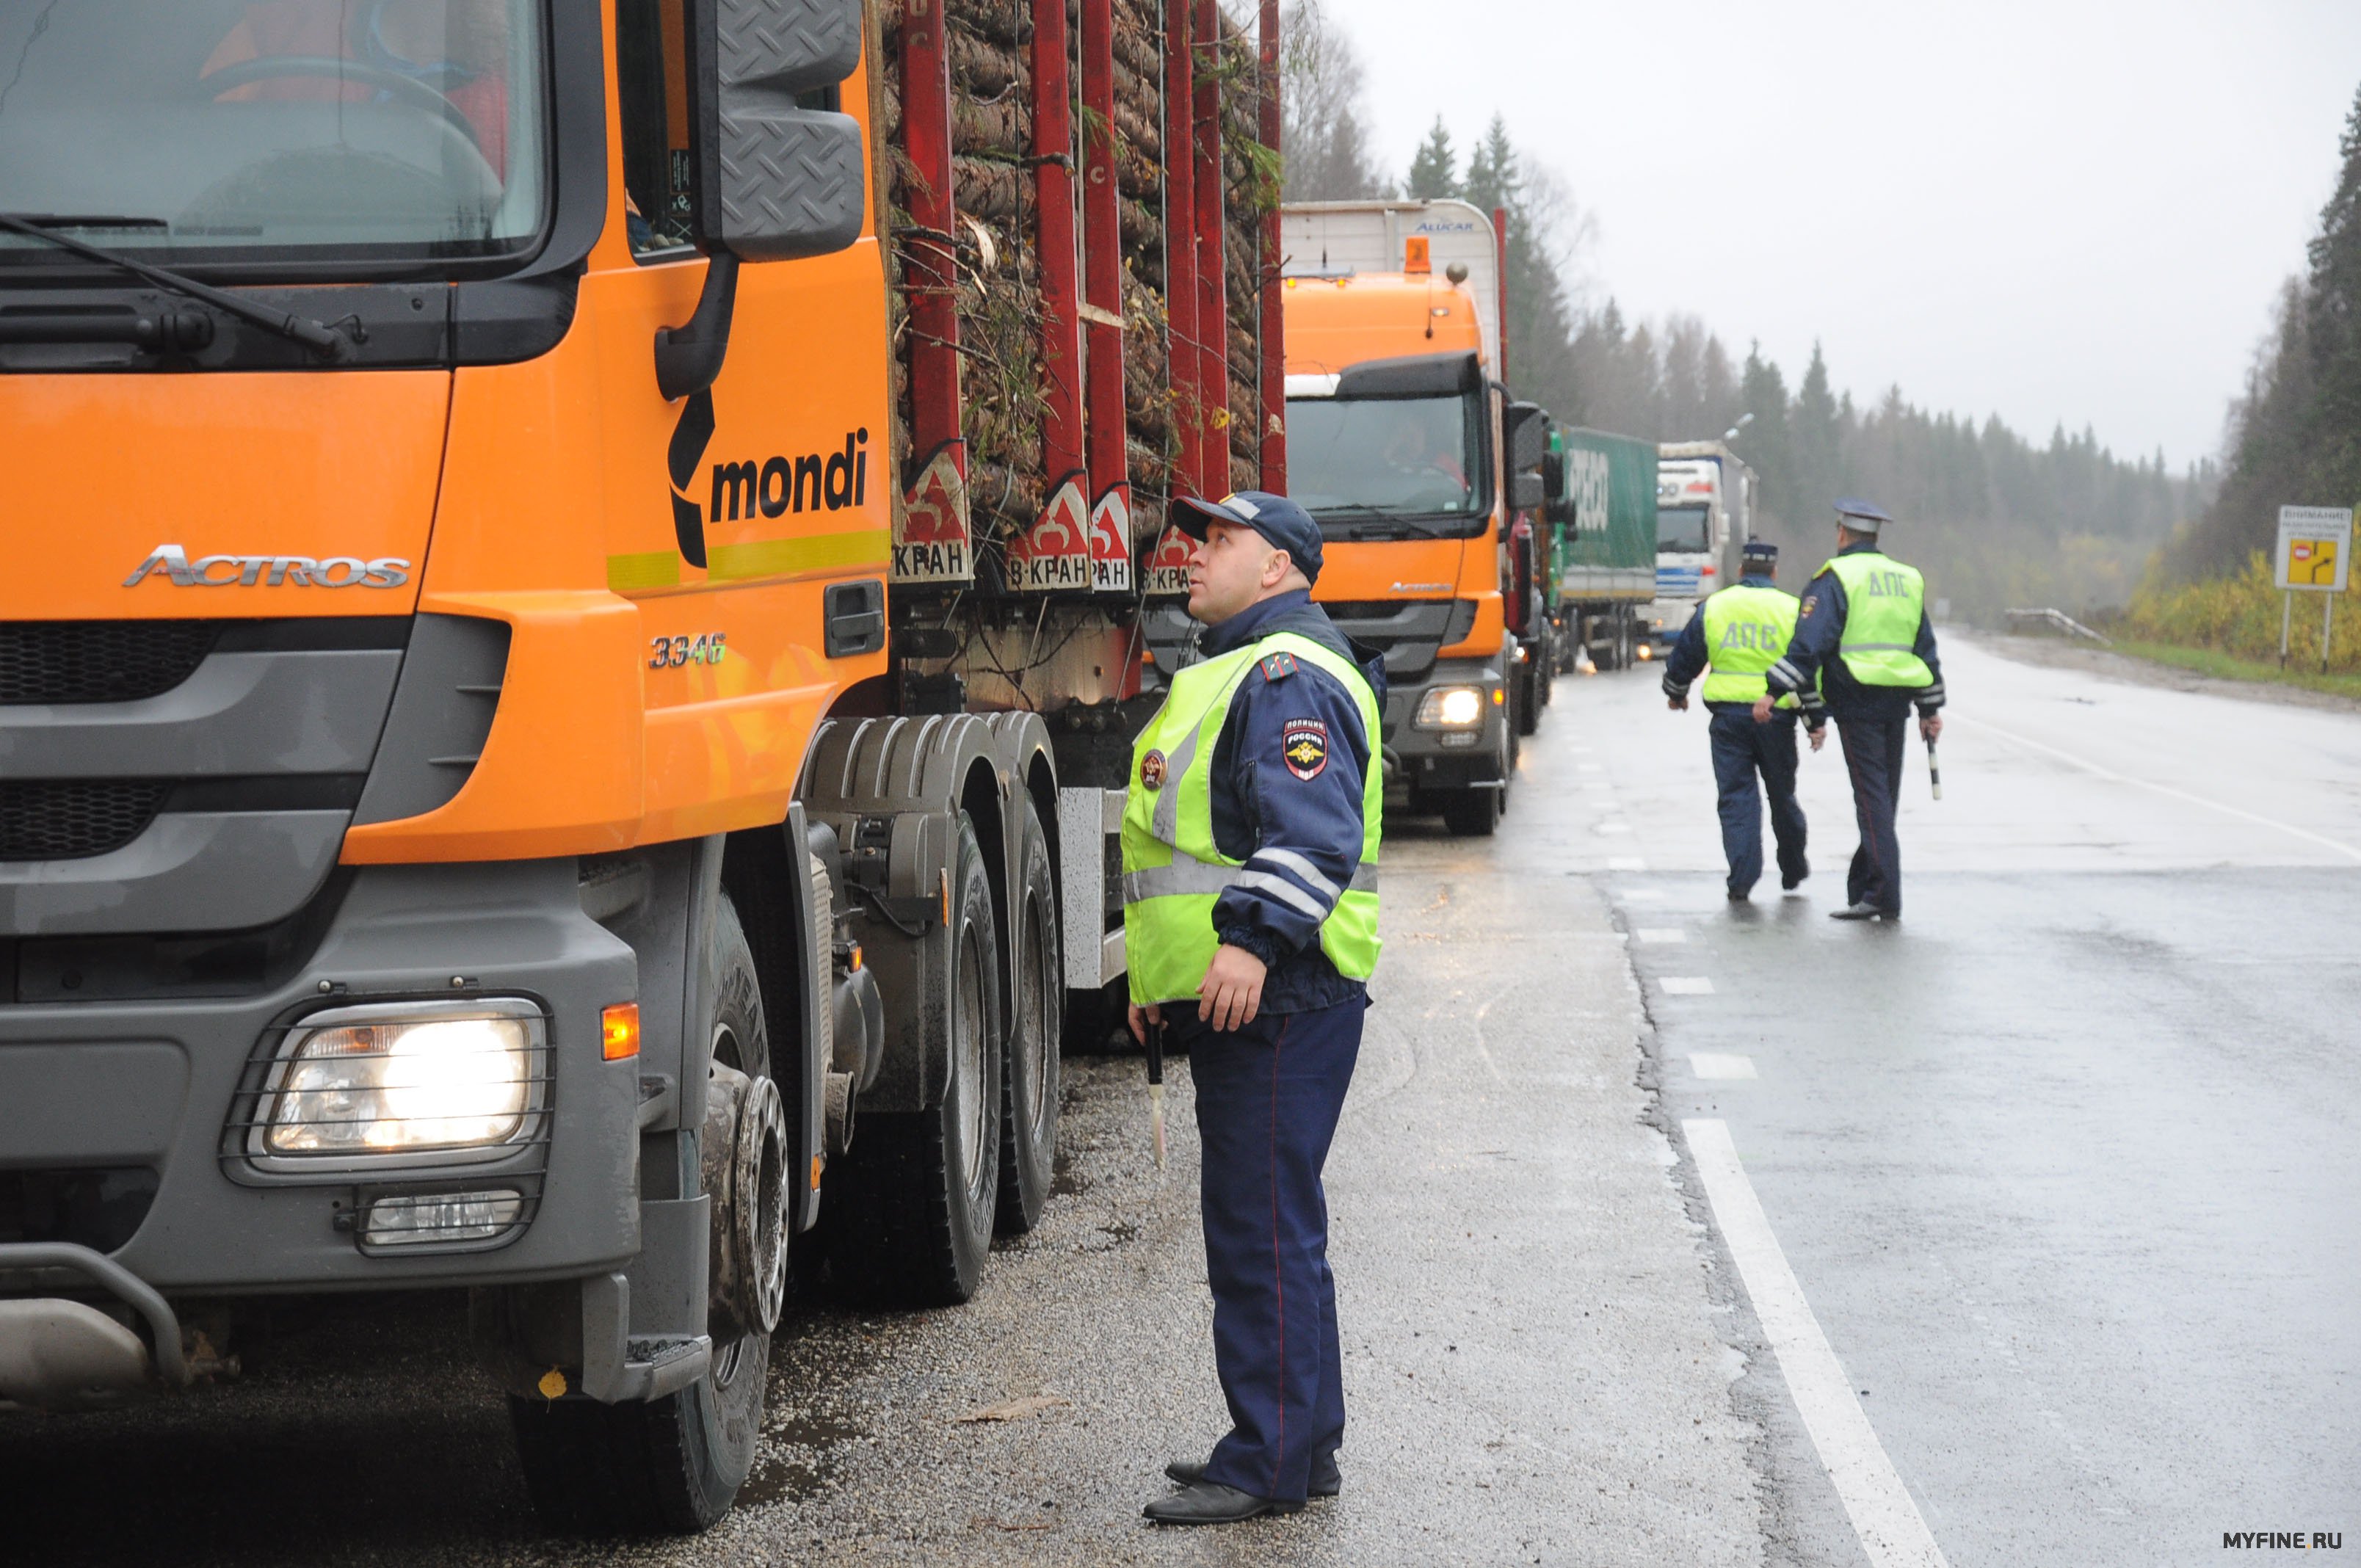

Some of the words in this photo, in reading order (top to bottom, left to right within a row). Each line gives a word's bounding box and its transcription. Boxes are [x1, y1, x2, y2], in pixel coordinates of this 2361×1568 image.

[710, 427, 868, 523] mondi
[1868, 572, 1909, 598] ДПС
[1719, 622, 1777, 650] ДПС
[649, 633, 726, 669] 3346
[1287, 719, 1324, 730] ПОЛИЦИЯ
[1288, 733, 1322, 747] РОССИЯ
